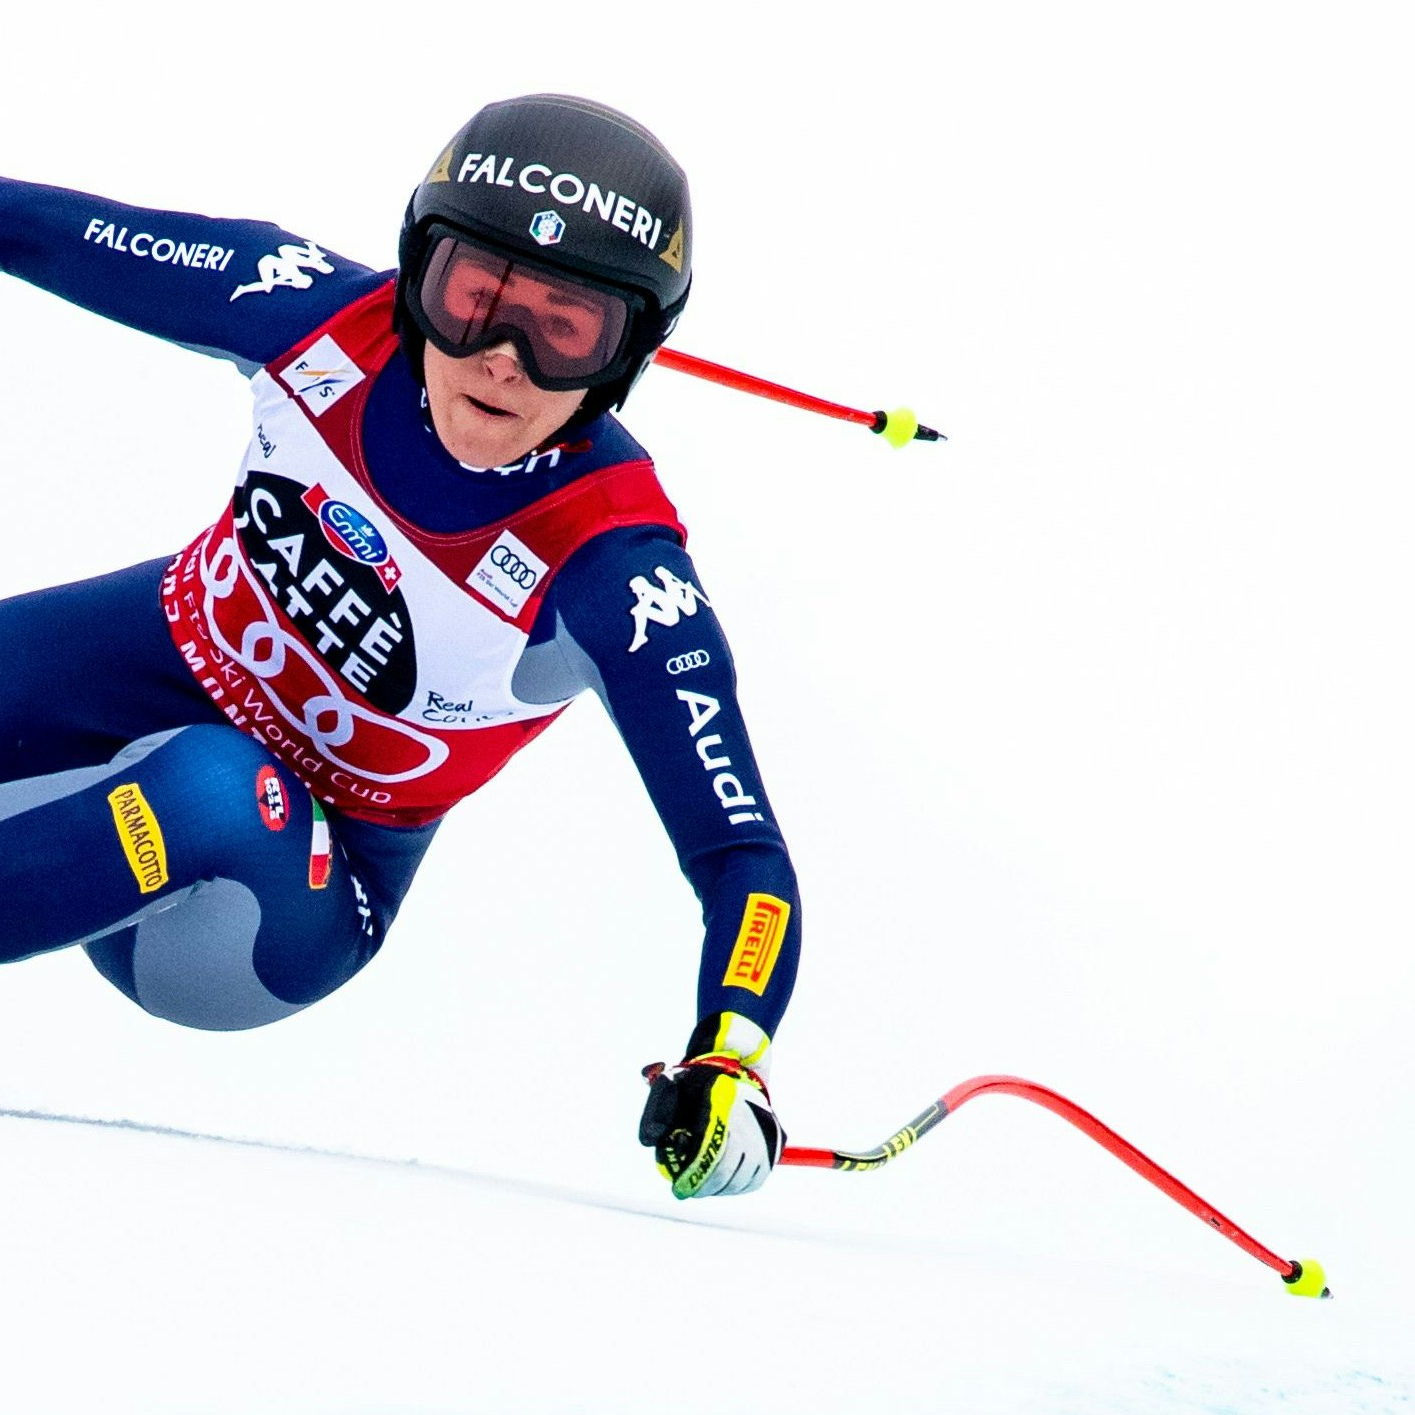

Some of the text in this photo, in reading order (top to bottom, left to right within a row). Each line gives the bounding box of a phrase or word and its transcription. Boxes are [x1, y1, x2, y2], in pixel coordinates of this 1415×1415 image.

[457, 153, 662, 250] FALCONERI
[83, 218, 235, 271] FALCONERI
[328, 504, 383, 561] Emmi
[250, 488, 403, 666] CAFFÈ
[243, 688, 324, 773] World
[427, 690, 473, 712] Real
[675, 689, 765, 825] Audi
[115, 789, 163, 888] PARMACOTTO
[735, 901, 782, 982] PIRELLI
